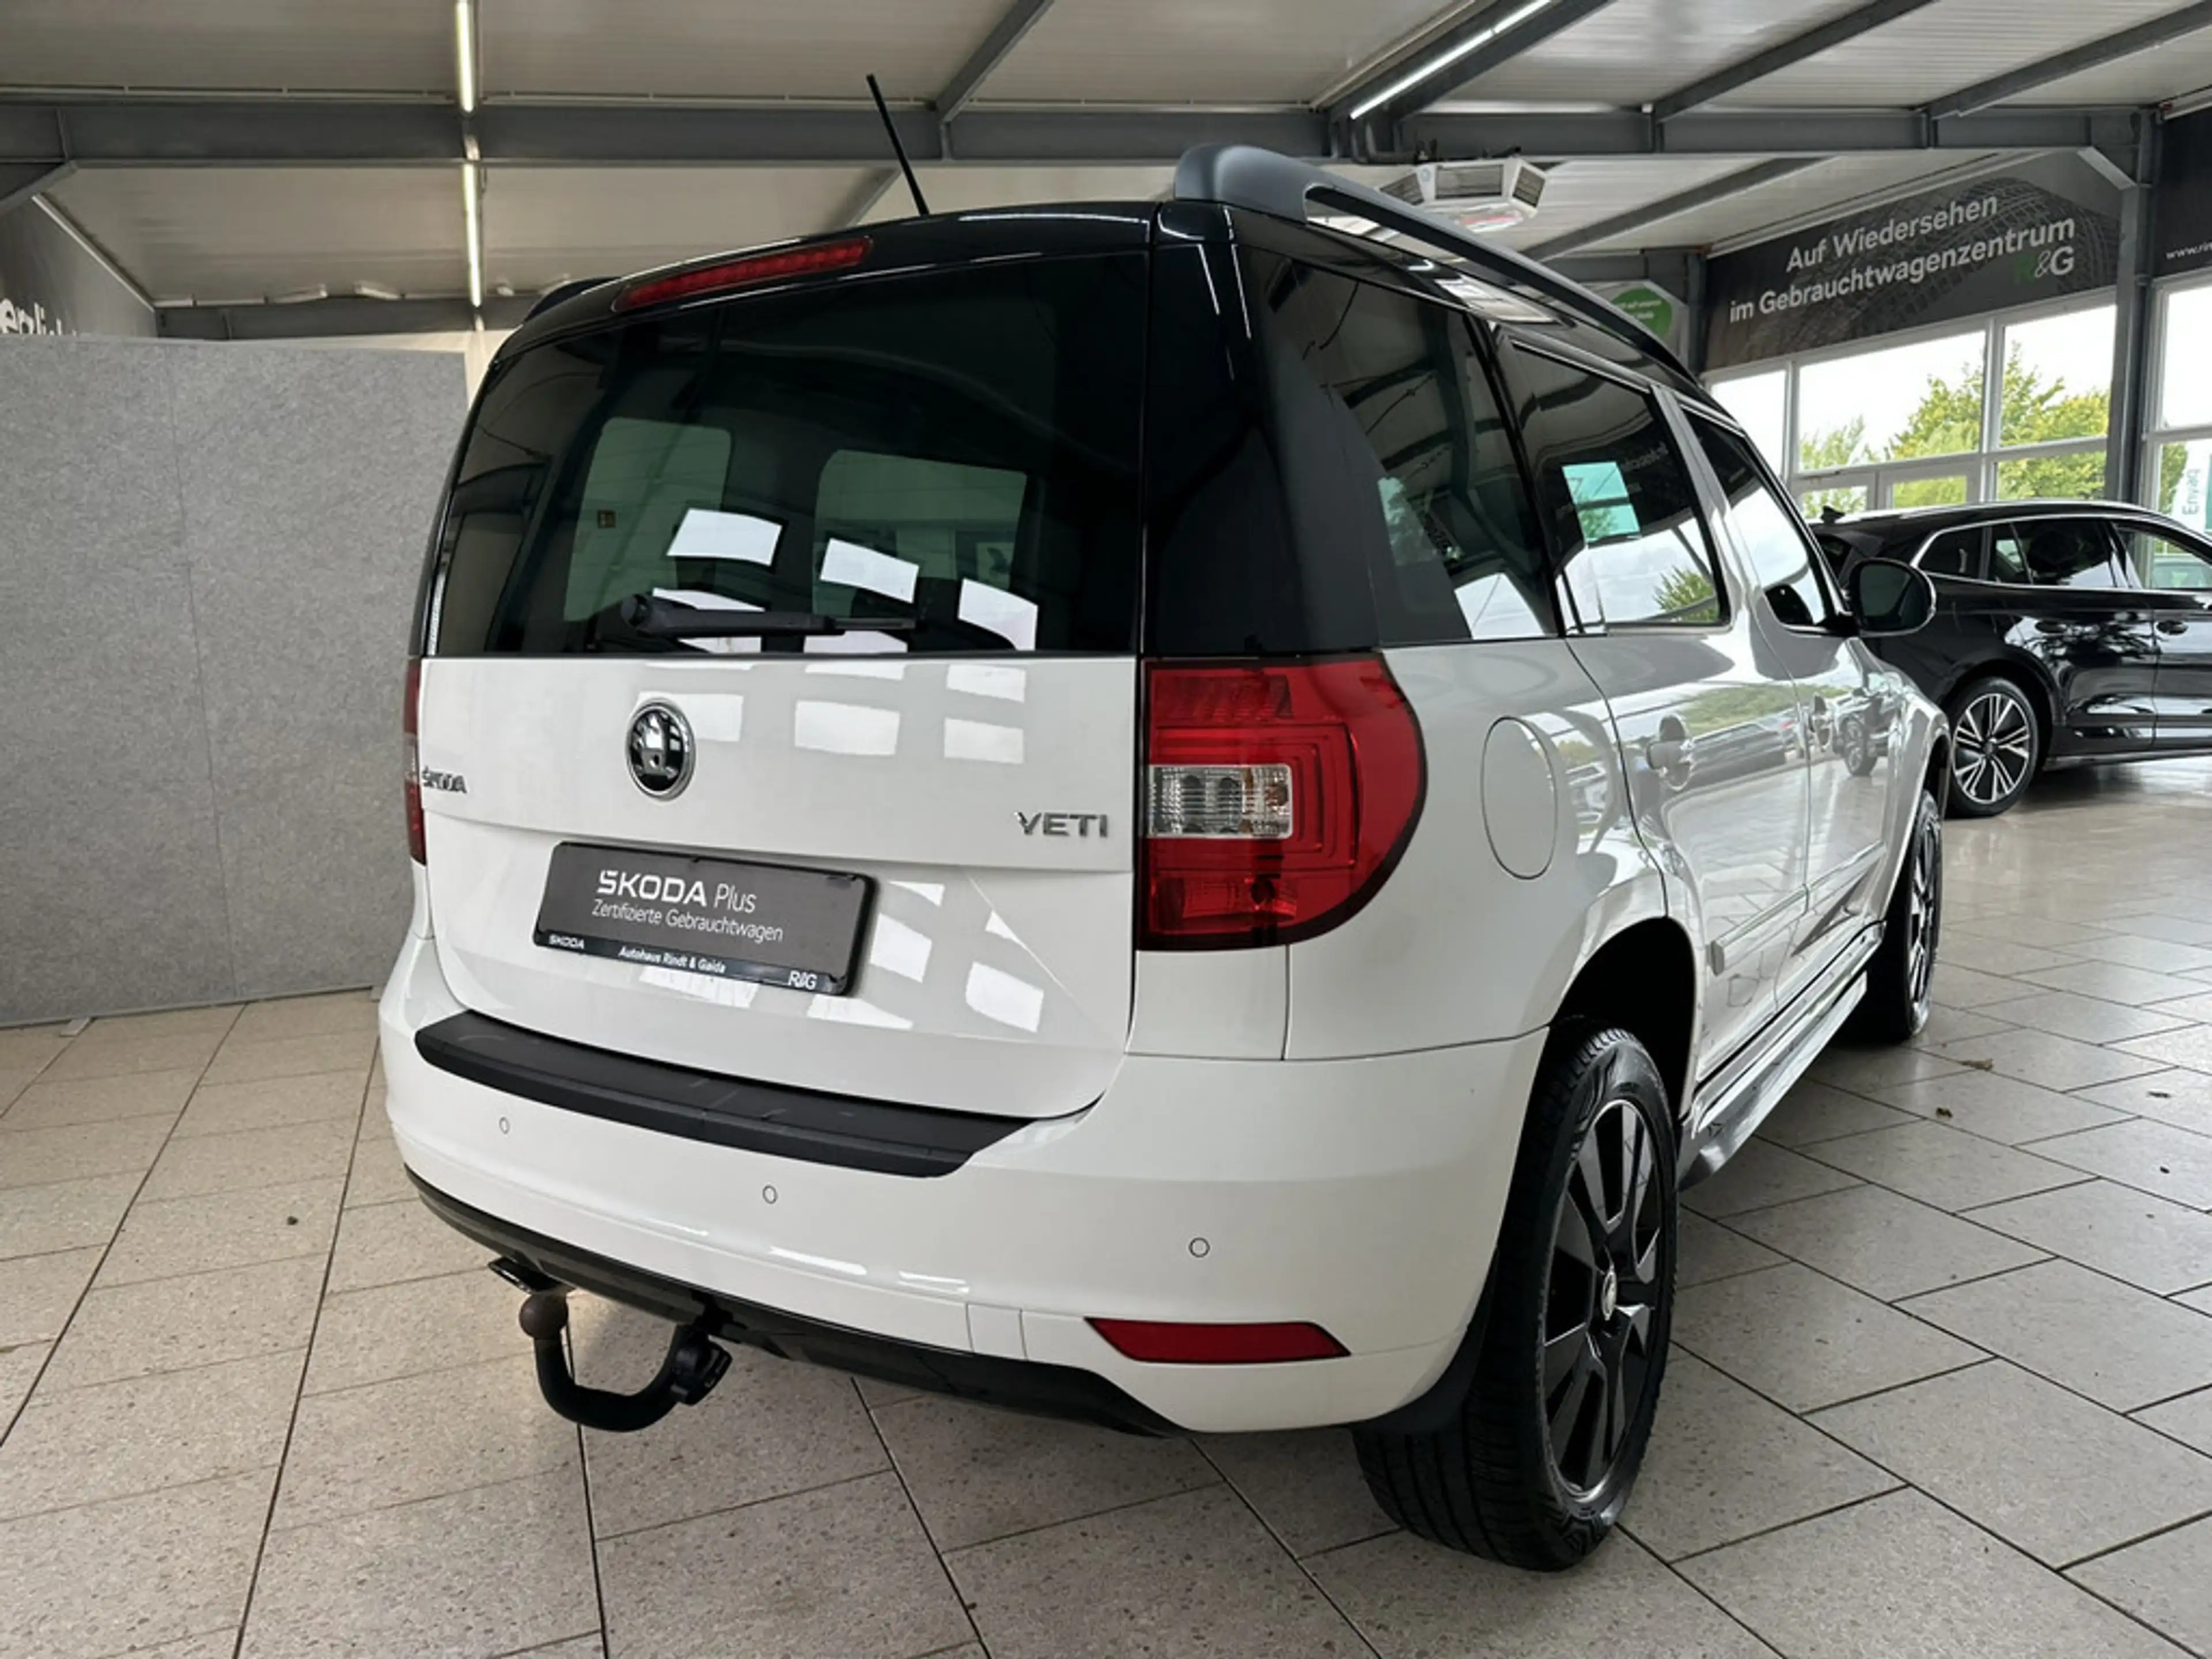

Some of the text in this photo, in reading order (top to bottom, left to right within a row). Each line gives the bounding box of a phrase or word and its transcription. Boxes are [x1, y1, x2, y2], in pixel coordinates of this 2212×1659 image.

[1786, 196, 1998, 273] Auf Wiedersehen
[1730, 218, 2075, 323] im Gebrauchtwagenzentrum
[1013, 812, 1108, 838] YETI
[713, 883, 757, 913] Plus
[592, 899, 783, 944] Zertifizierte Gebrauchtwagen
[618, 945, 661, 964] Autohaus
